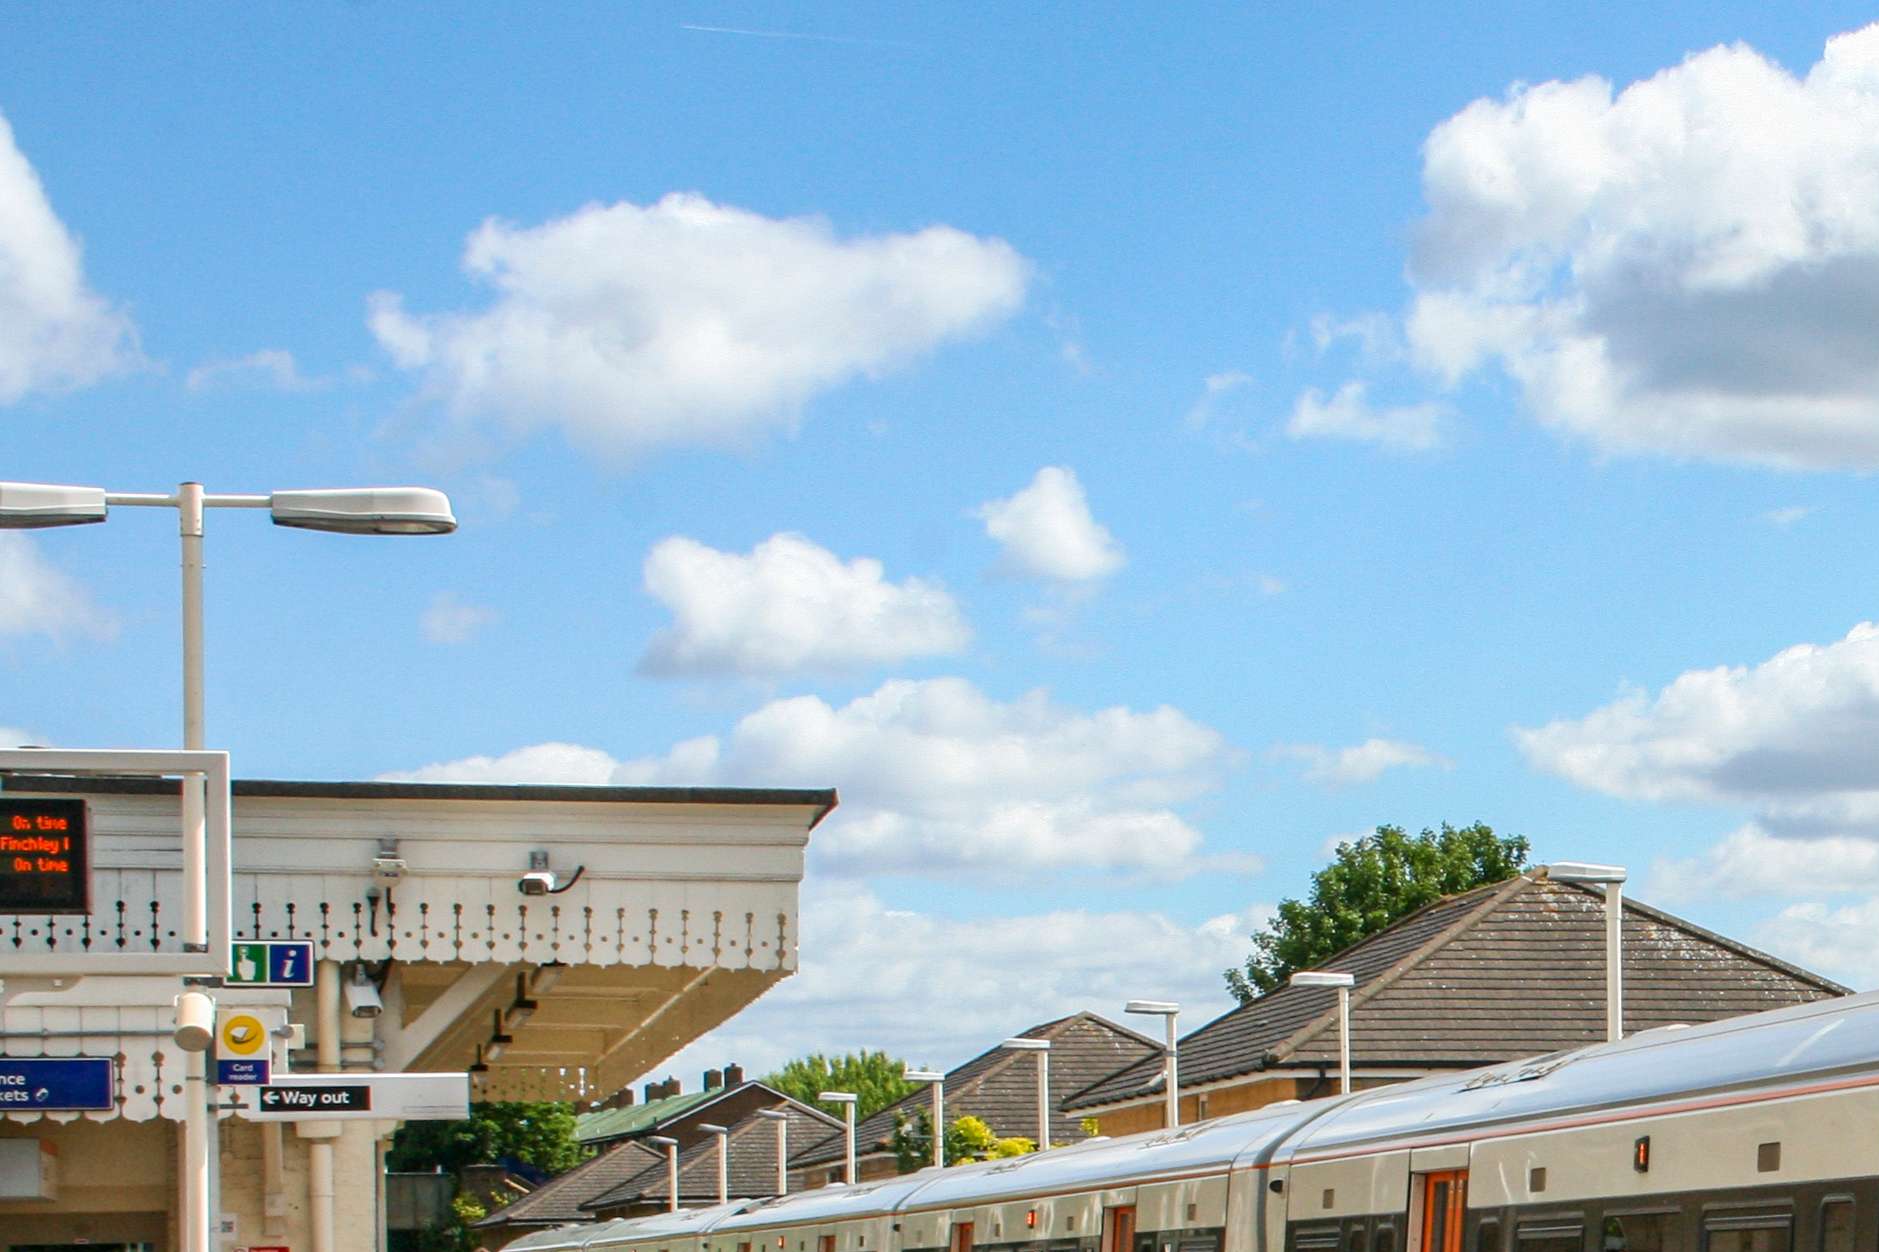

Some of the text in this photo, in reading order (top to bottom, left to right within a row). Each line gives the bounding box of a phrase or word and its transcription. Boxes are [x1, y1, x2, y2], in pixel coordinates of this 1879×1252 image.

[14, 857, 32, 872] On
[232, 1063, 254, 1072] Card
[281, 1091, 350, 1107] Way out
